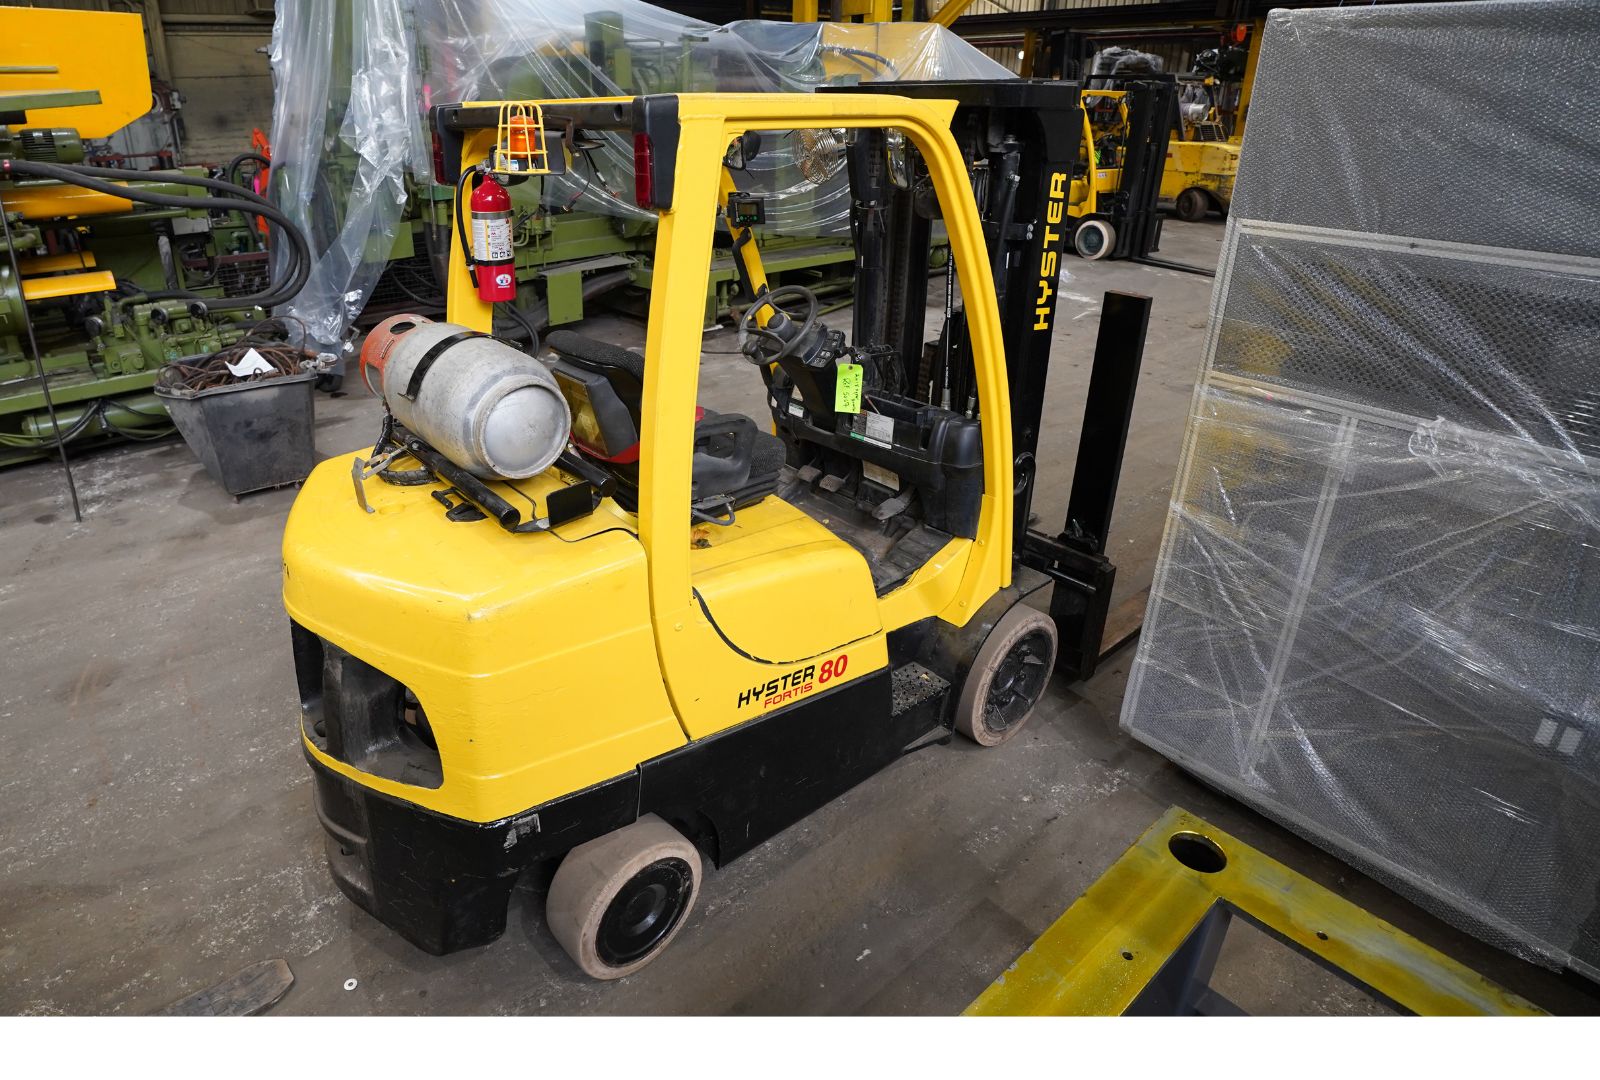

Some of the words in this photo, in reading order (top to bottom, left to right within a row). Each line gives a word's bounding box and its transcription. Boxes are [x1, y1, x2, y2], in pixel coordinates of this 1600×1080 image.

[1033, 172, 1067, 331] HYSTER
[737, 665, 815, 709] HYSTER
[818, 654, 848, 684] 80
[764, 682, 813, 708] FORTIS
